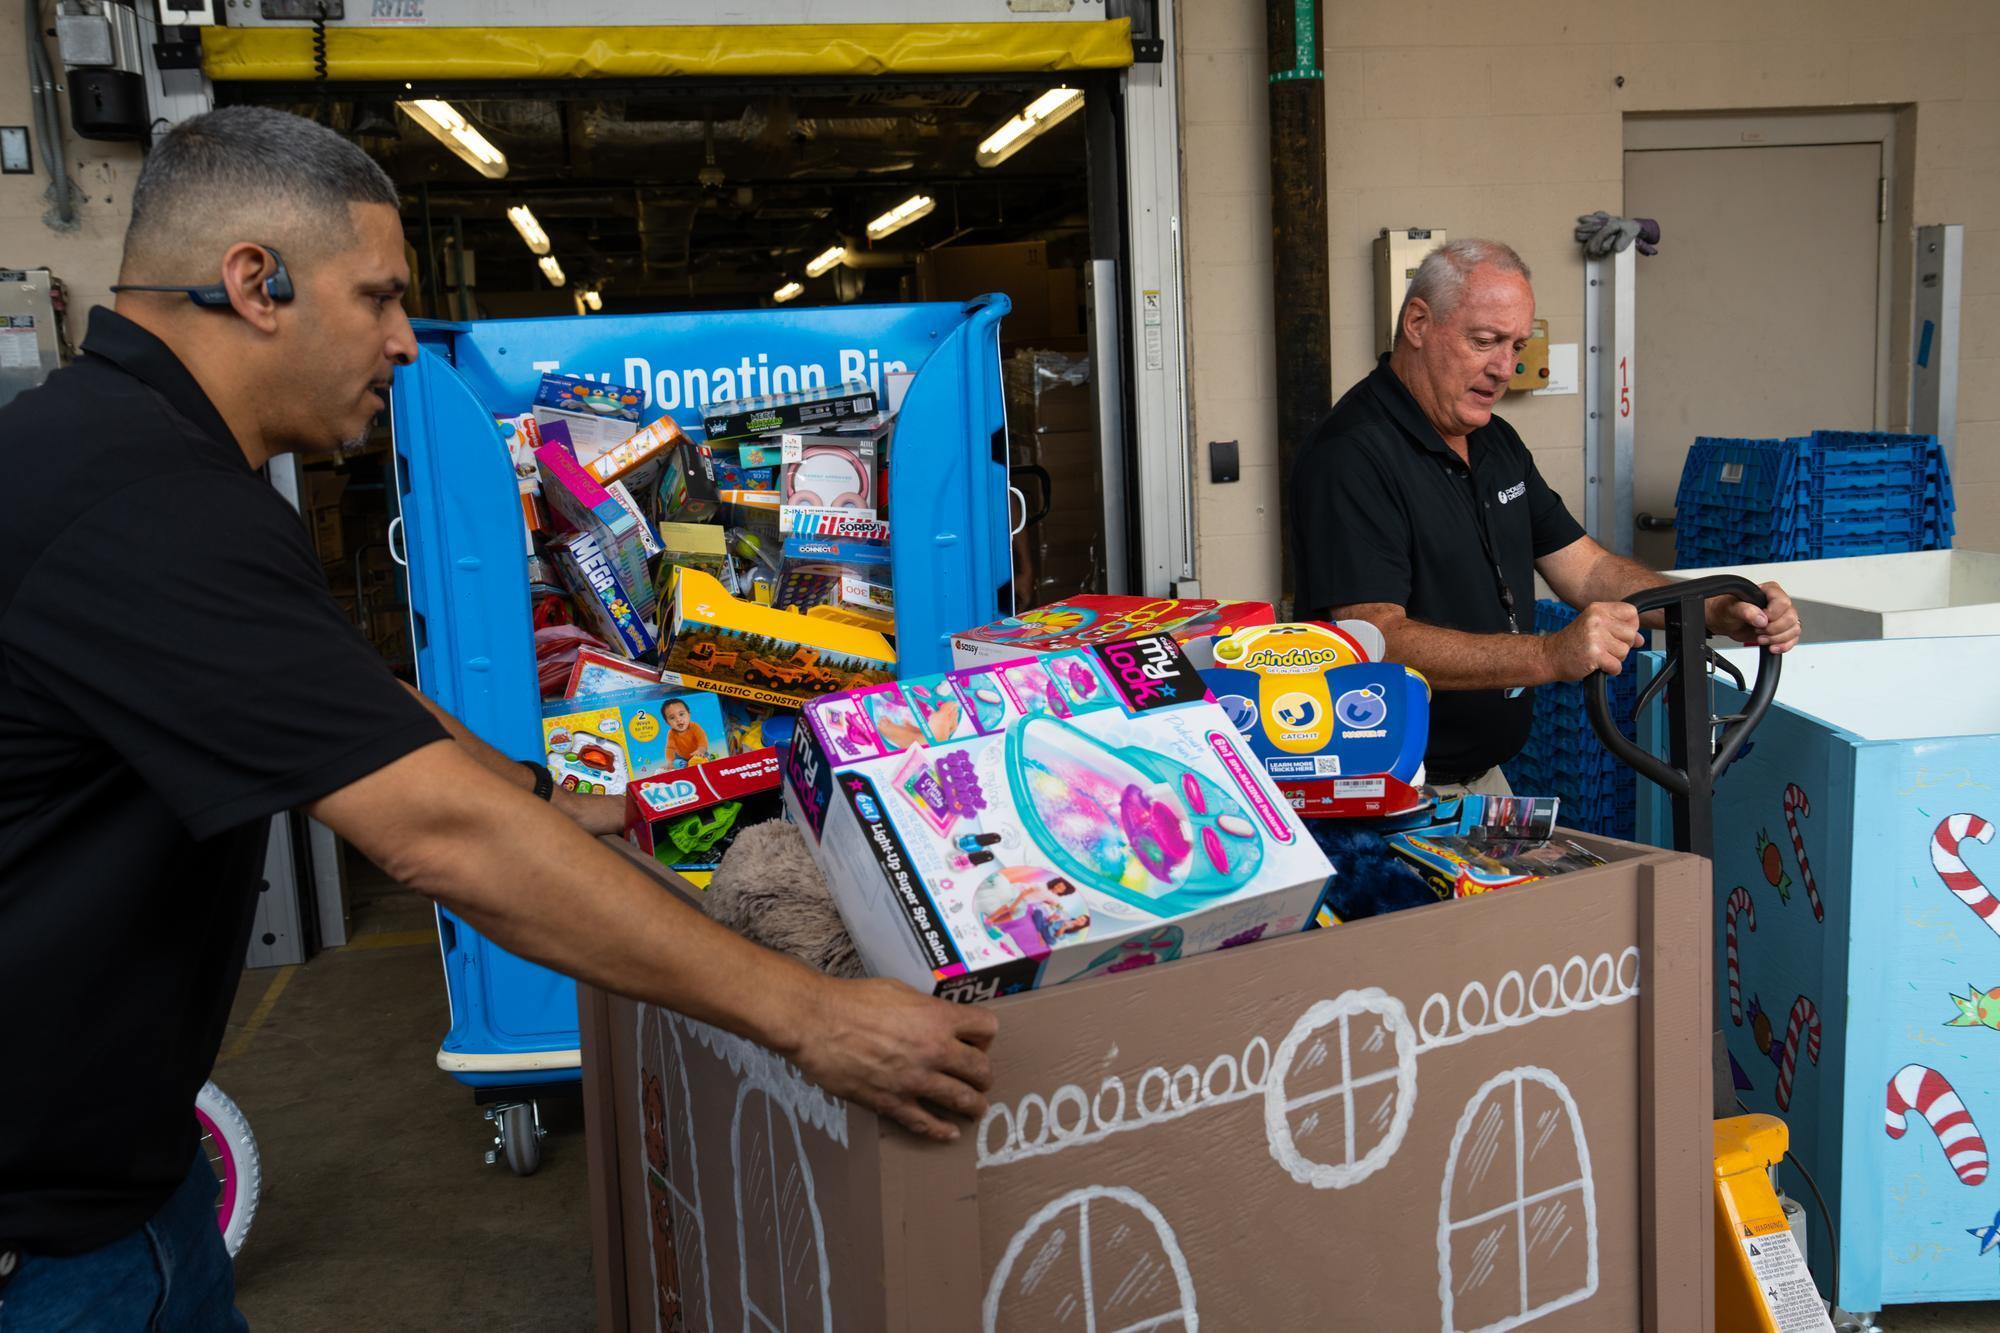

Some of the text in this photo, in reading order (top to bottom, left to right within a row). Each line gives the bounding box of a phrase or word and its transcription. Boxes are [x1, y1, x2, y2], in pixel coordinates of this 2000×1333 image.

[624, 353, 825, 411] Donation
[840, 522, 881, 533] SORRY!
[569, 533, 616, 594] MEGA
[961, 641, 978, 655] sassy
[1136, 637, 1181, 680] my
[1246, 648, 1335, 669] pindaloo
[696, 680, 751, 697] REALISTIC
[638, 710, 646, 721] 2
[720, 761, 762, 776] Monster
[741, 769, 762, 779] Play
[643, 781, 694, 804] KID
[871, 823, 901, 870] Light-Up
[896, 871, 919, 906] Super
[913, 906, 930, 932] Spa
[925, 932, 949, 965] Salon
[1754, 1221, 1784, 1232] WARNING
